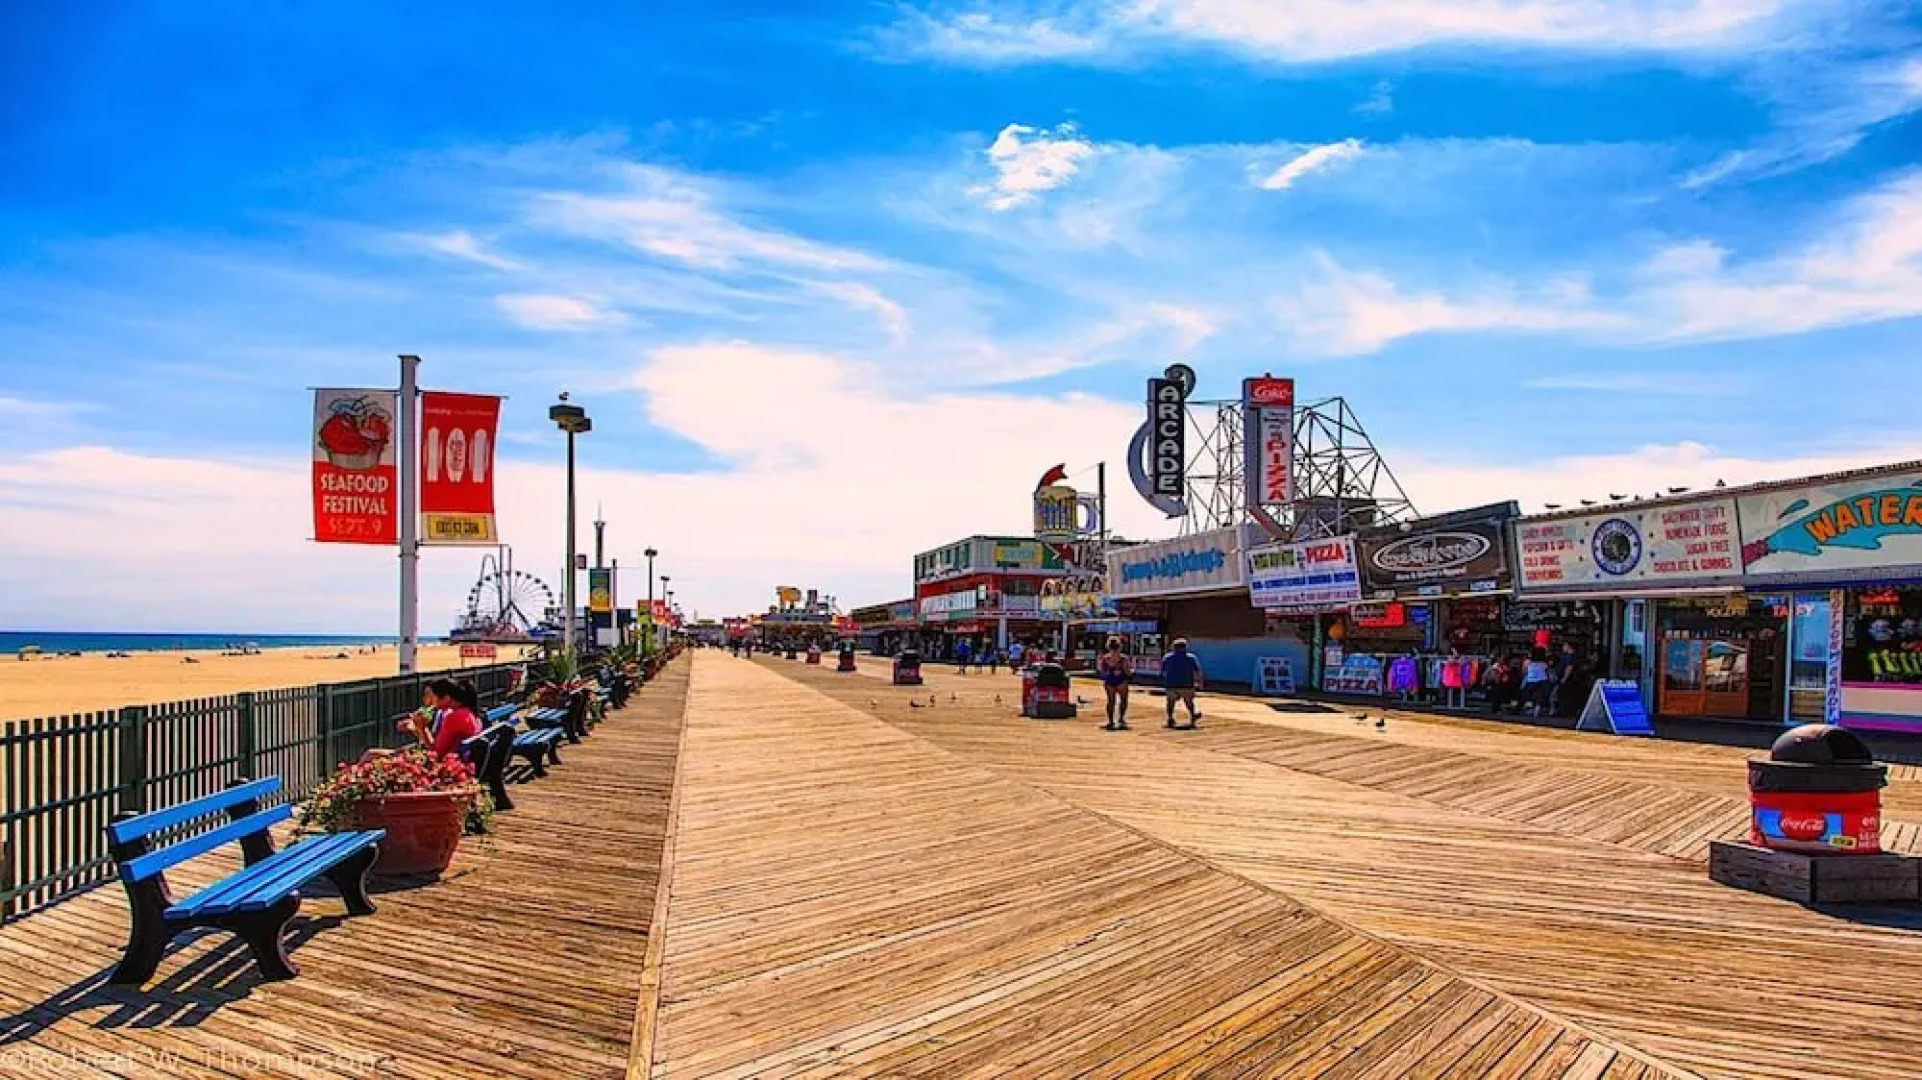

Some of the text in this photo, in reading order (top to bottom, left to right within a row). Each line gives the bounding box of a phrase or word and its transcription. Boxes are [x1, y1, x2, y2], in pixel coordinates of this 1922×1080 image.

[1158, 385, 1180, 491] ARCADE
[1266, 441, 1286, 500] PIZZA
[320, 474, 389, 493] SEAFOOD
[322, 495, 388, 515] FESTIVAL
[373, 518, 383, 535] 9
[1805, 495, 1922, 543] WATER
[1705, 522, 1729, 536] FUDGE
[1305, 543, 1345, 563] PIZZA
[1685, 540, 1730, 555] SUGAR FREE
[1653, 560, 1690, 573] CHOCOLATE
[1692, 559, 1698, 571] &
[1324, 677, 1380, 692] PIZZA
